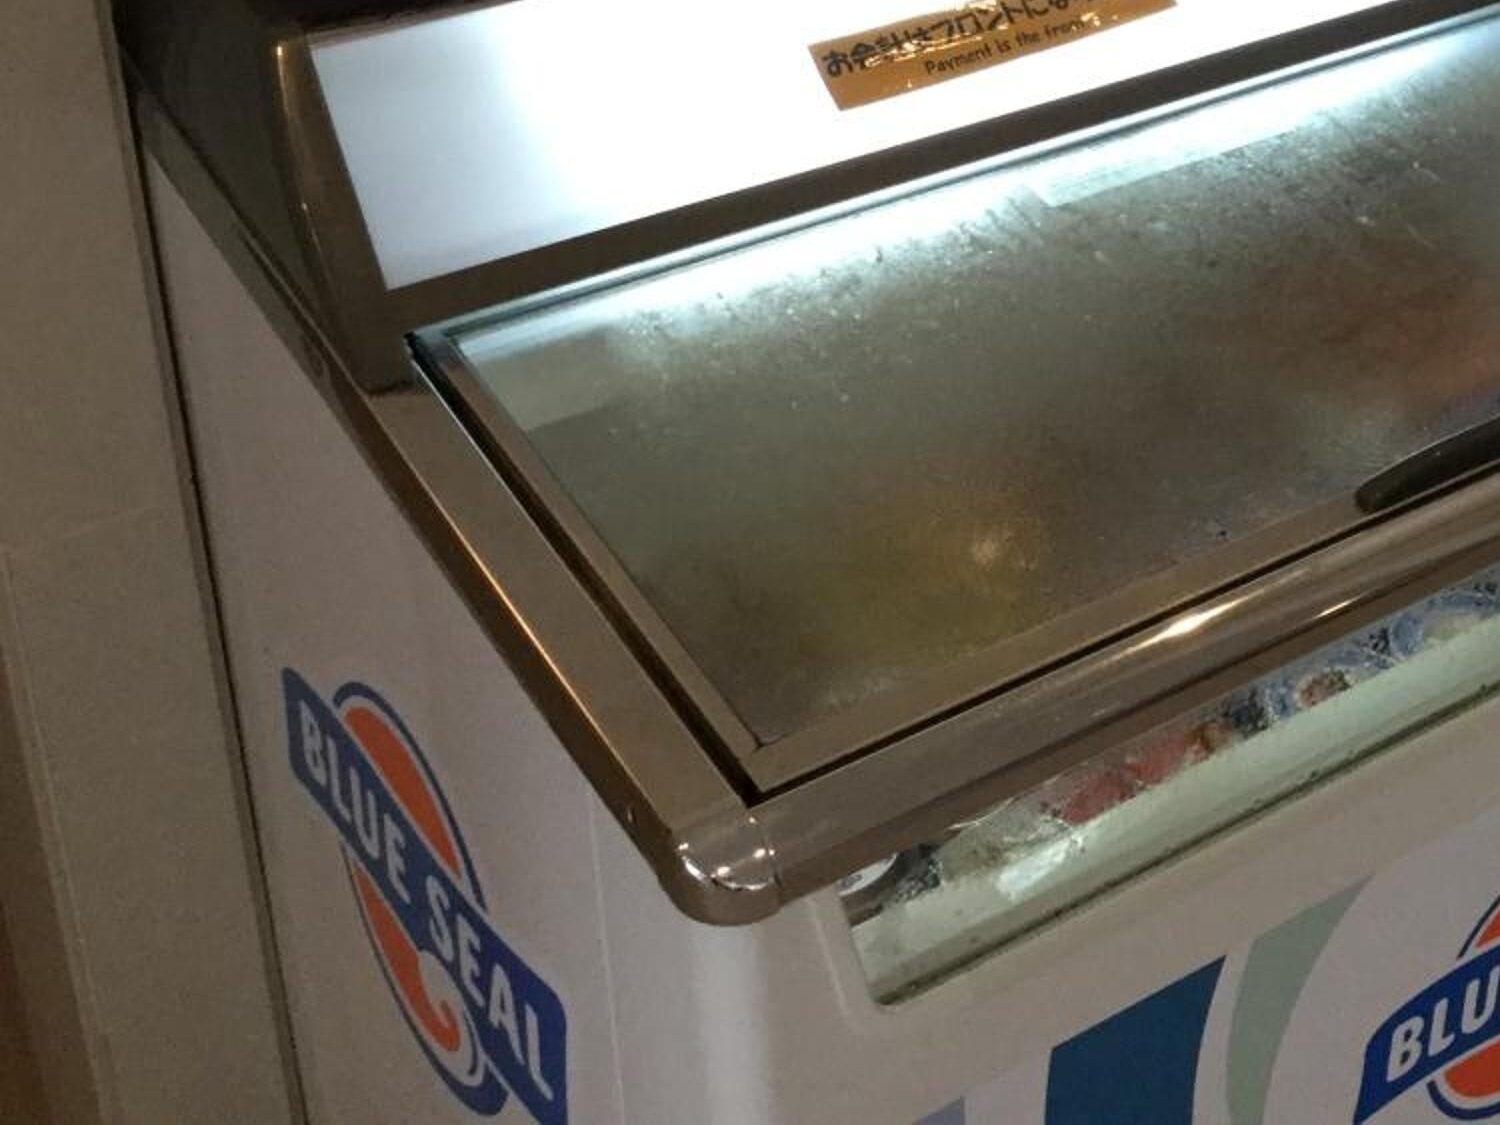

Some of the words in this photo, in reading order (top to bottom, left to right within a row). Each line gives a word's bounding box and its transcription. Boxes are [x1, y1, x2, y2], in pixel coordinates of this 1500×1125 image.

[925, 42, 993, 75] Payment
[995, 39, 1011, 54] is
[1016, 29, 1041, 48] the
[299, 699, 411, 904] BLUE
[426, 875, 554, 1101] SEAL
